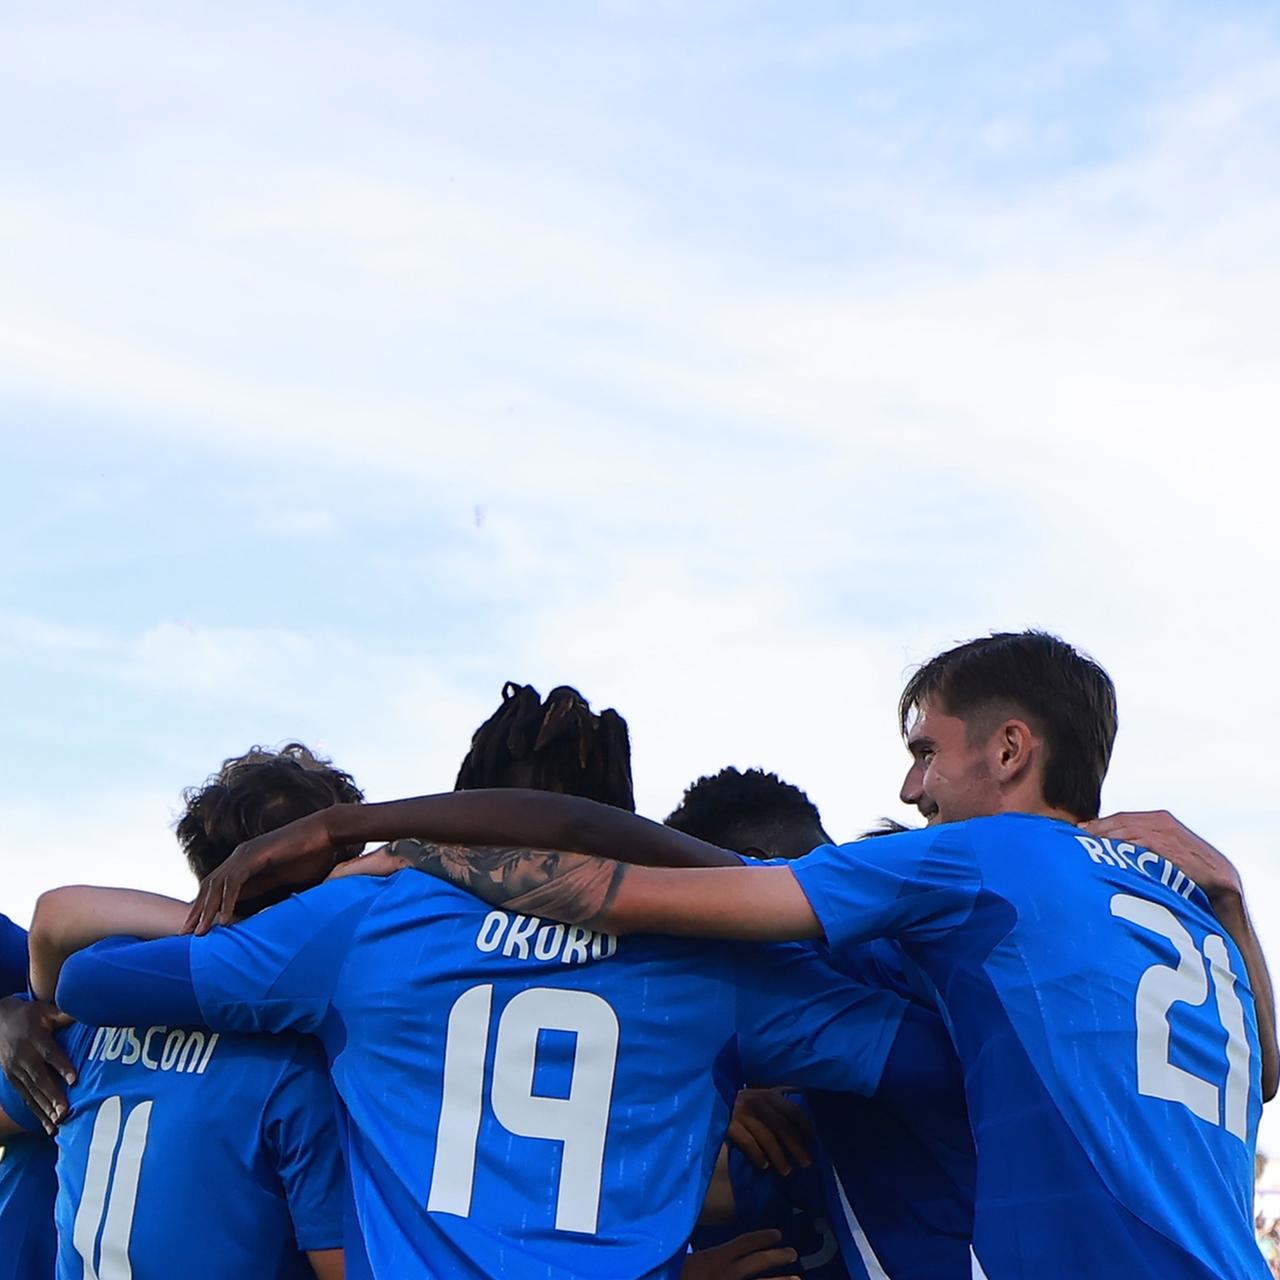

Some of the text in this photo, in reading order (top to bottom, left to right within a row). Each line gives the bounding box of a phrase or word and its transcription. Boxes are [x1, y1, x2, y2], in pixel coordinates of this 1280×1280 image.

[476, 911, 617, 964] OKORO
[1110, 893, 1250, 1144] 21
[426, 984, 619, 1234] 19
